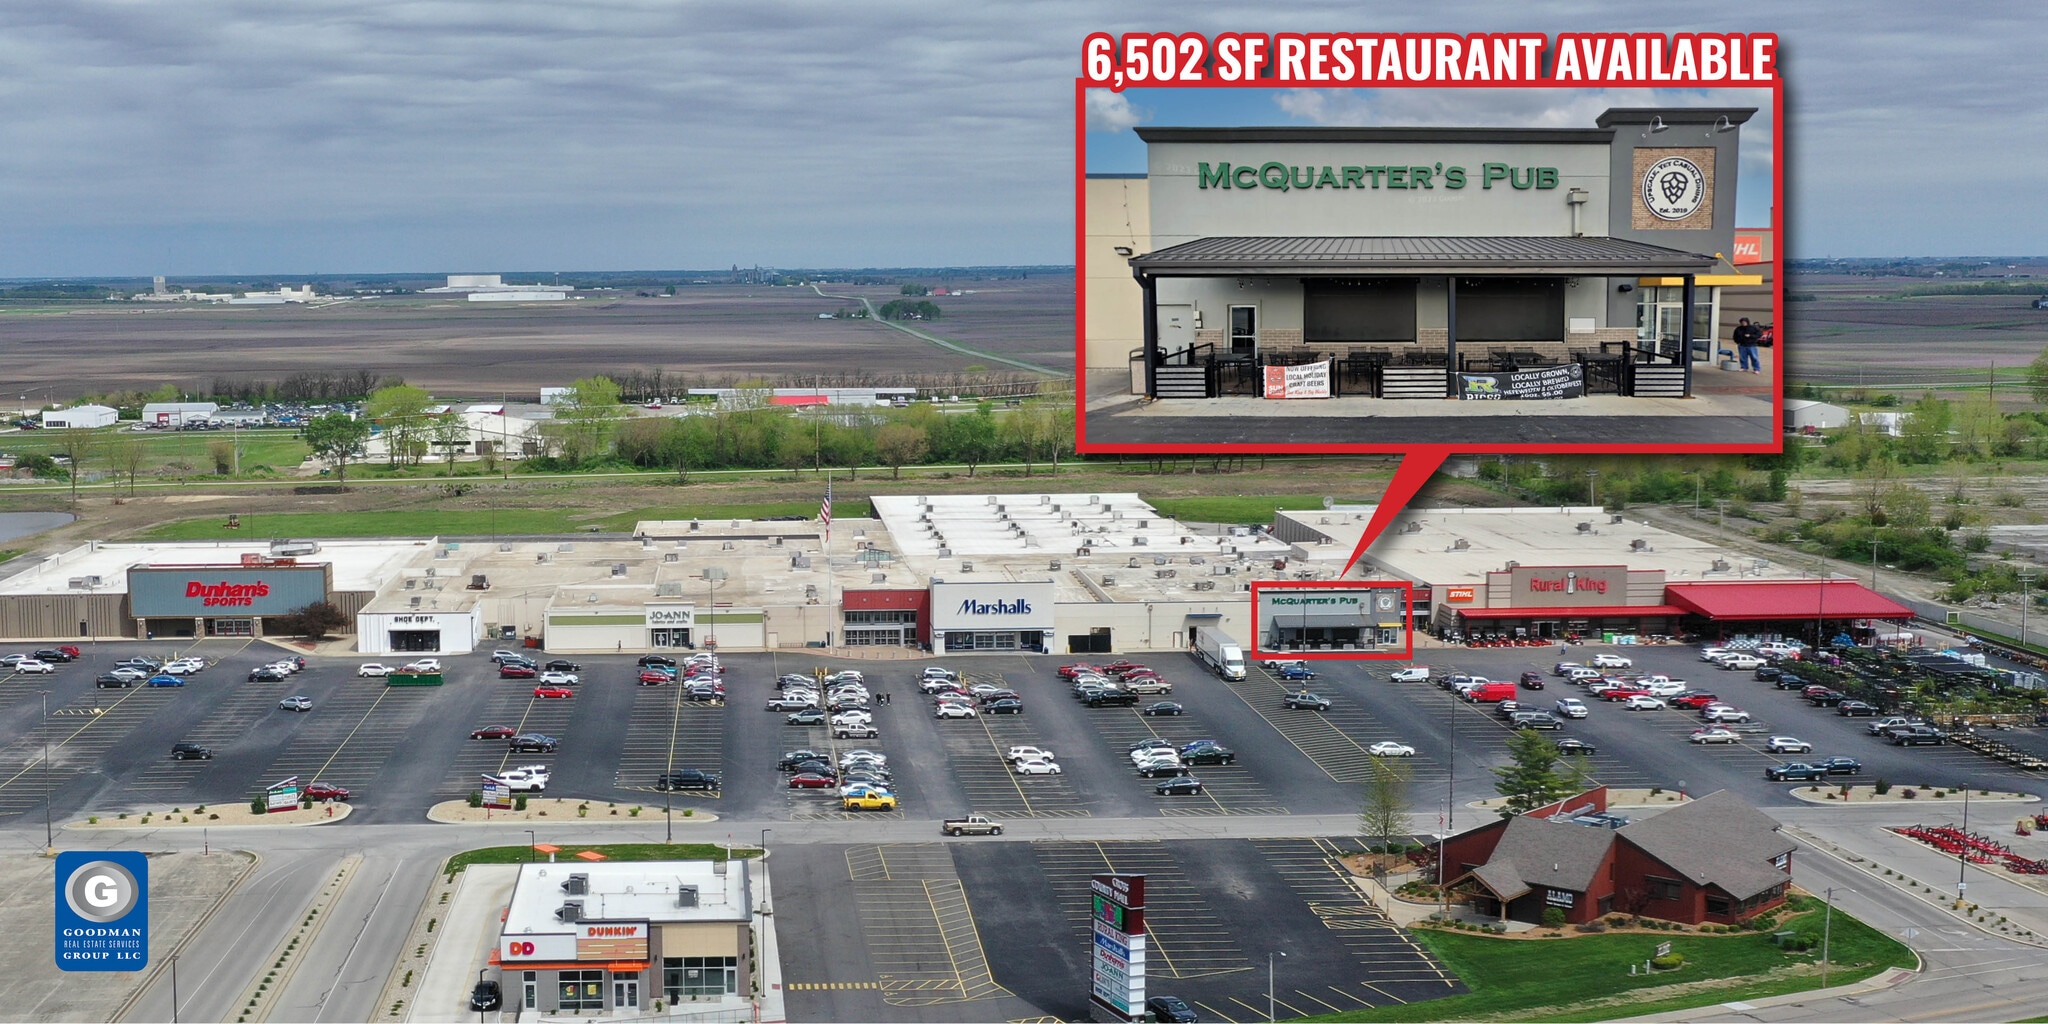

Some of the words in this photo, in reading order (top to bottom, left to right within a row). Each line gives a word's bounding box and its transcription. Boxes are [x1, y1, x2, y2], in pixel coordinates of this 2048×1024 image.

[1658, 161, 1672, 170] YET
[1673, 160, 1697, 178] CASUAL
[1691, 178, 1702, 204] DINING
[1511, 372, 1540, 381] LOCALLY
[1541, 368, 1570, 379] GROWN,
[1511, 380, 1541, 389] LOCALLY
[1542, 376, 1569, 386] BREWED
[1546, 380, 1582, 391] OKTOBERFEST
[185, 580, 270, 598] Dunham's
[1530, 577, 1566, 592] Rural
[1575, 578, 1608, 593] King
[1449, 590, 1473, 598] STIHL
[203, 597, 253, 606] SPORTS
[957, 599, 1031, 615] Marshalls
[587, 926, 637, 937] DUNKIN'
[509, 941, 535, 956] DD
